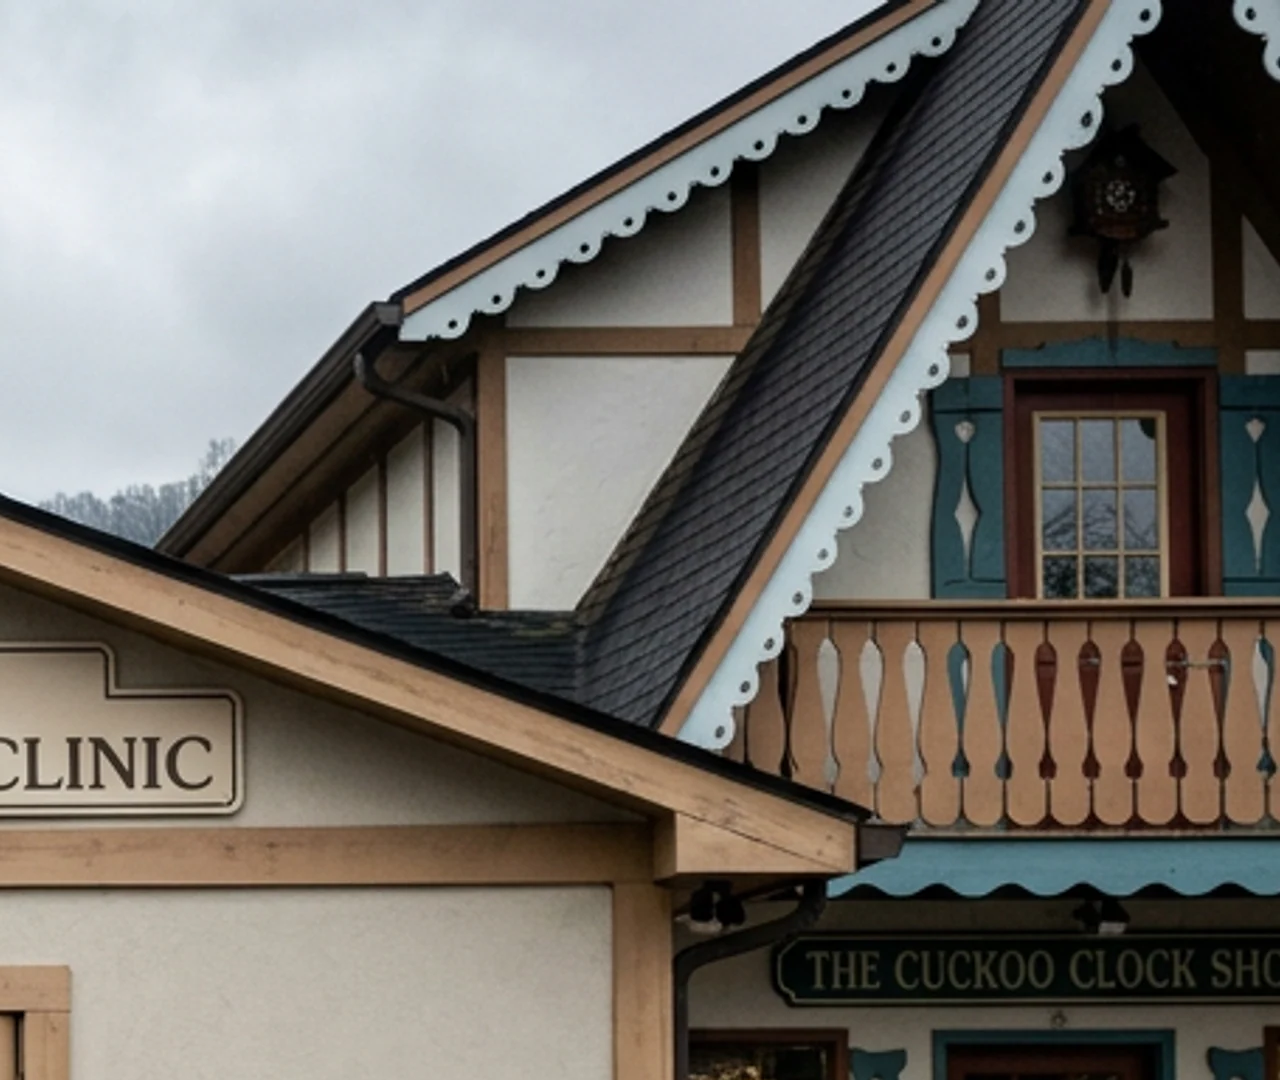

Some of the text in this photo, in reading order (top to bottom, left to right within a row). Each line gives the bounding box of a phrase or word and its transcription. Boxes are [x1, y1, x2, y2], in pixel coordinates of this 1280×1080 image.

[806, 950, 881, 990] THE
[894, 949, 1055, 990] CUCKOO
[1069, 948, 1197, 989] CLOCK
